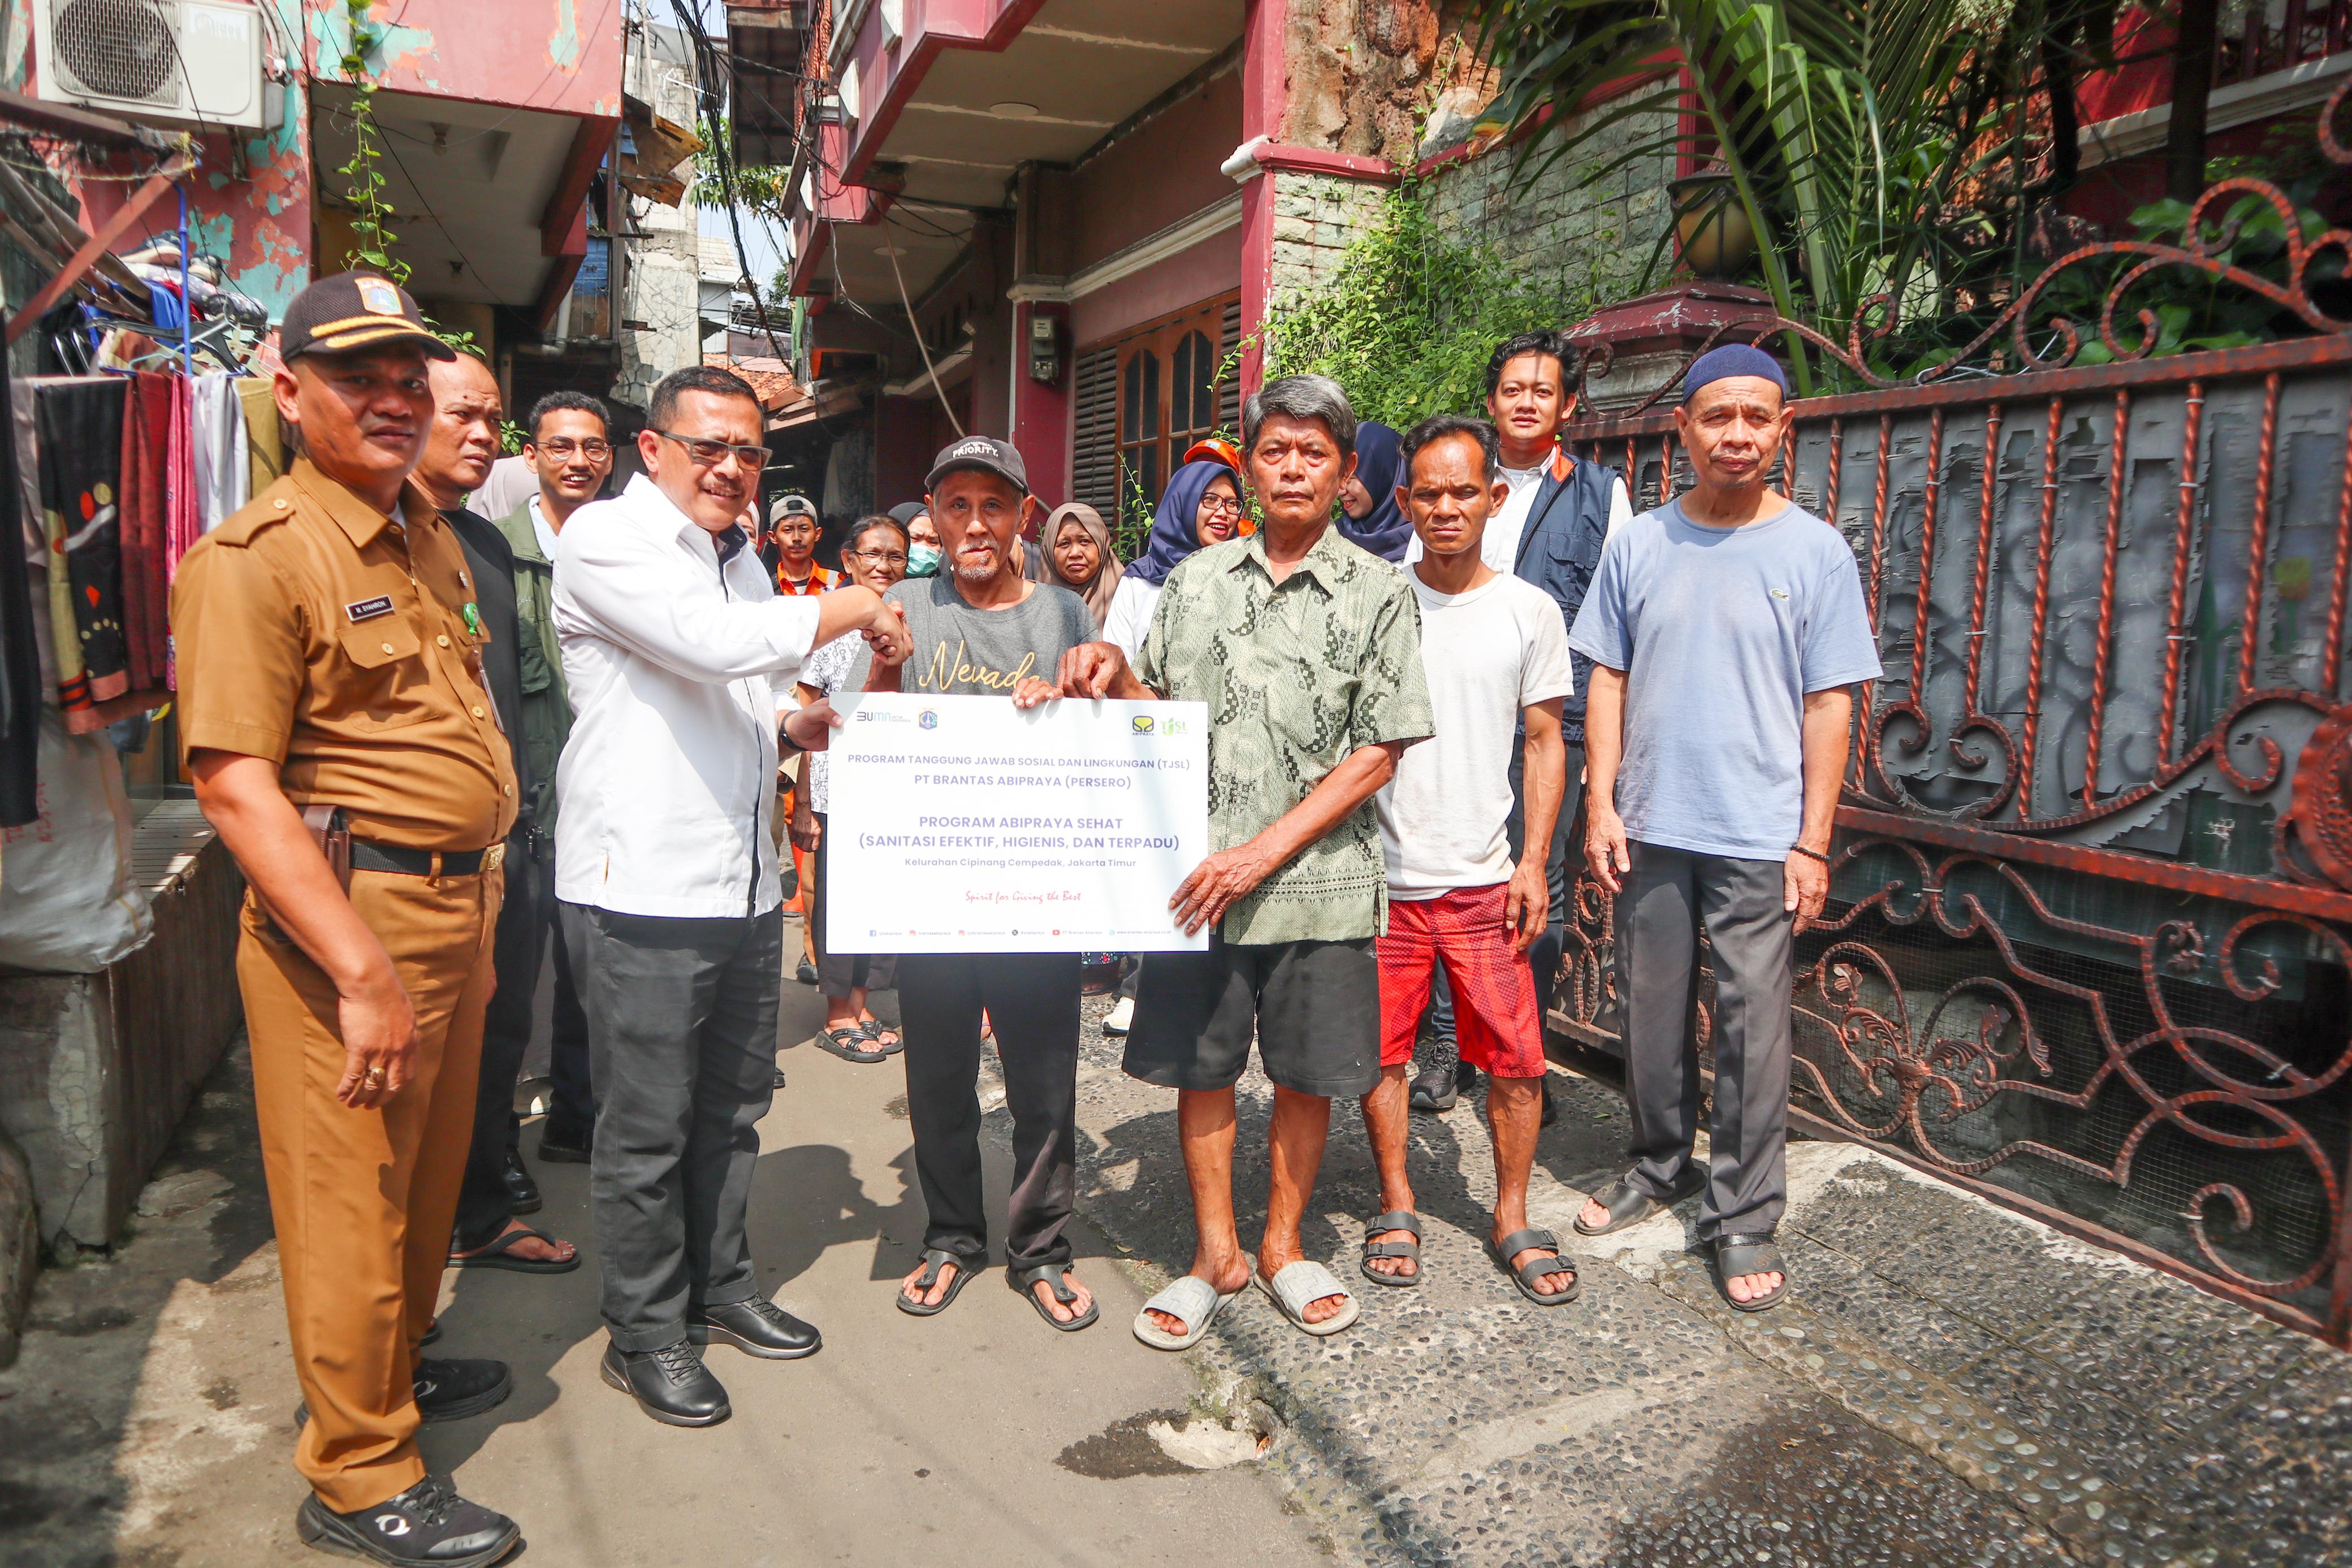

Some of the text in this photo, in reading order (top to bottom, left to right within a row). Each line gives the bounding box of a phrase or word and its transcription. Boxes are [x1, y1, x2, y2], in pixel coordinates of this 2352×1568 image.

[952, 446, 998, 458] PRIORITY.
[362, 600, 387, 612] SYAHRON
[919, 639, 1040, 691] Nevad
[848, 754, 1190, 771] PROGRAM TANGGUNG JAWAB SOSIAL DAN LINGKUNGAN (TJSL)
[914, 774, 1131, 790] PT BRANTAS ABIPRAYA (PERSERO)
[919, 816, 1123, 829] PROGRAM ABIPRAYA SEHAT
[859, 832, 1179, 852] (SANITASI EFEKTIF, HIGIENIS, DAN TERPADU)
[959, 858, 1006, 869] Cipinang
[1008, 859, 1065, 869] Cempedak,
[1067, 859, 1106, 867] Jakarta
[1108, 859, 1136, 867] Timur
[965, 890, 1082, 905] Spirit for Giving the Best
